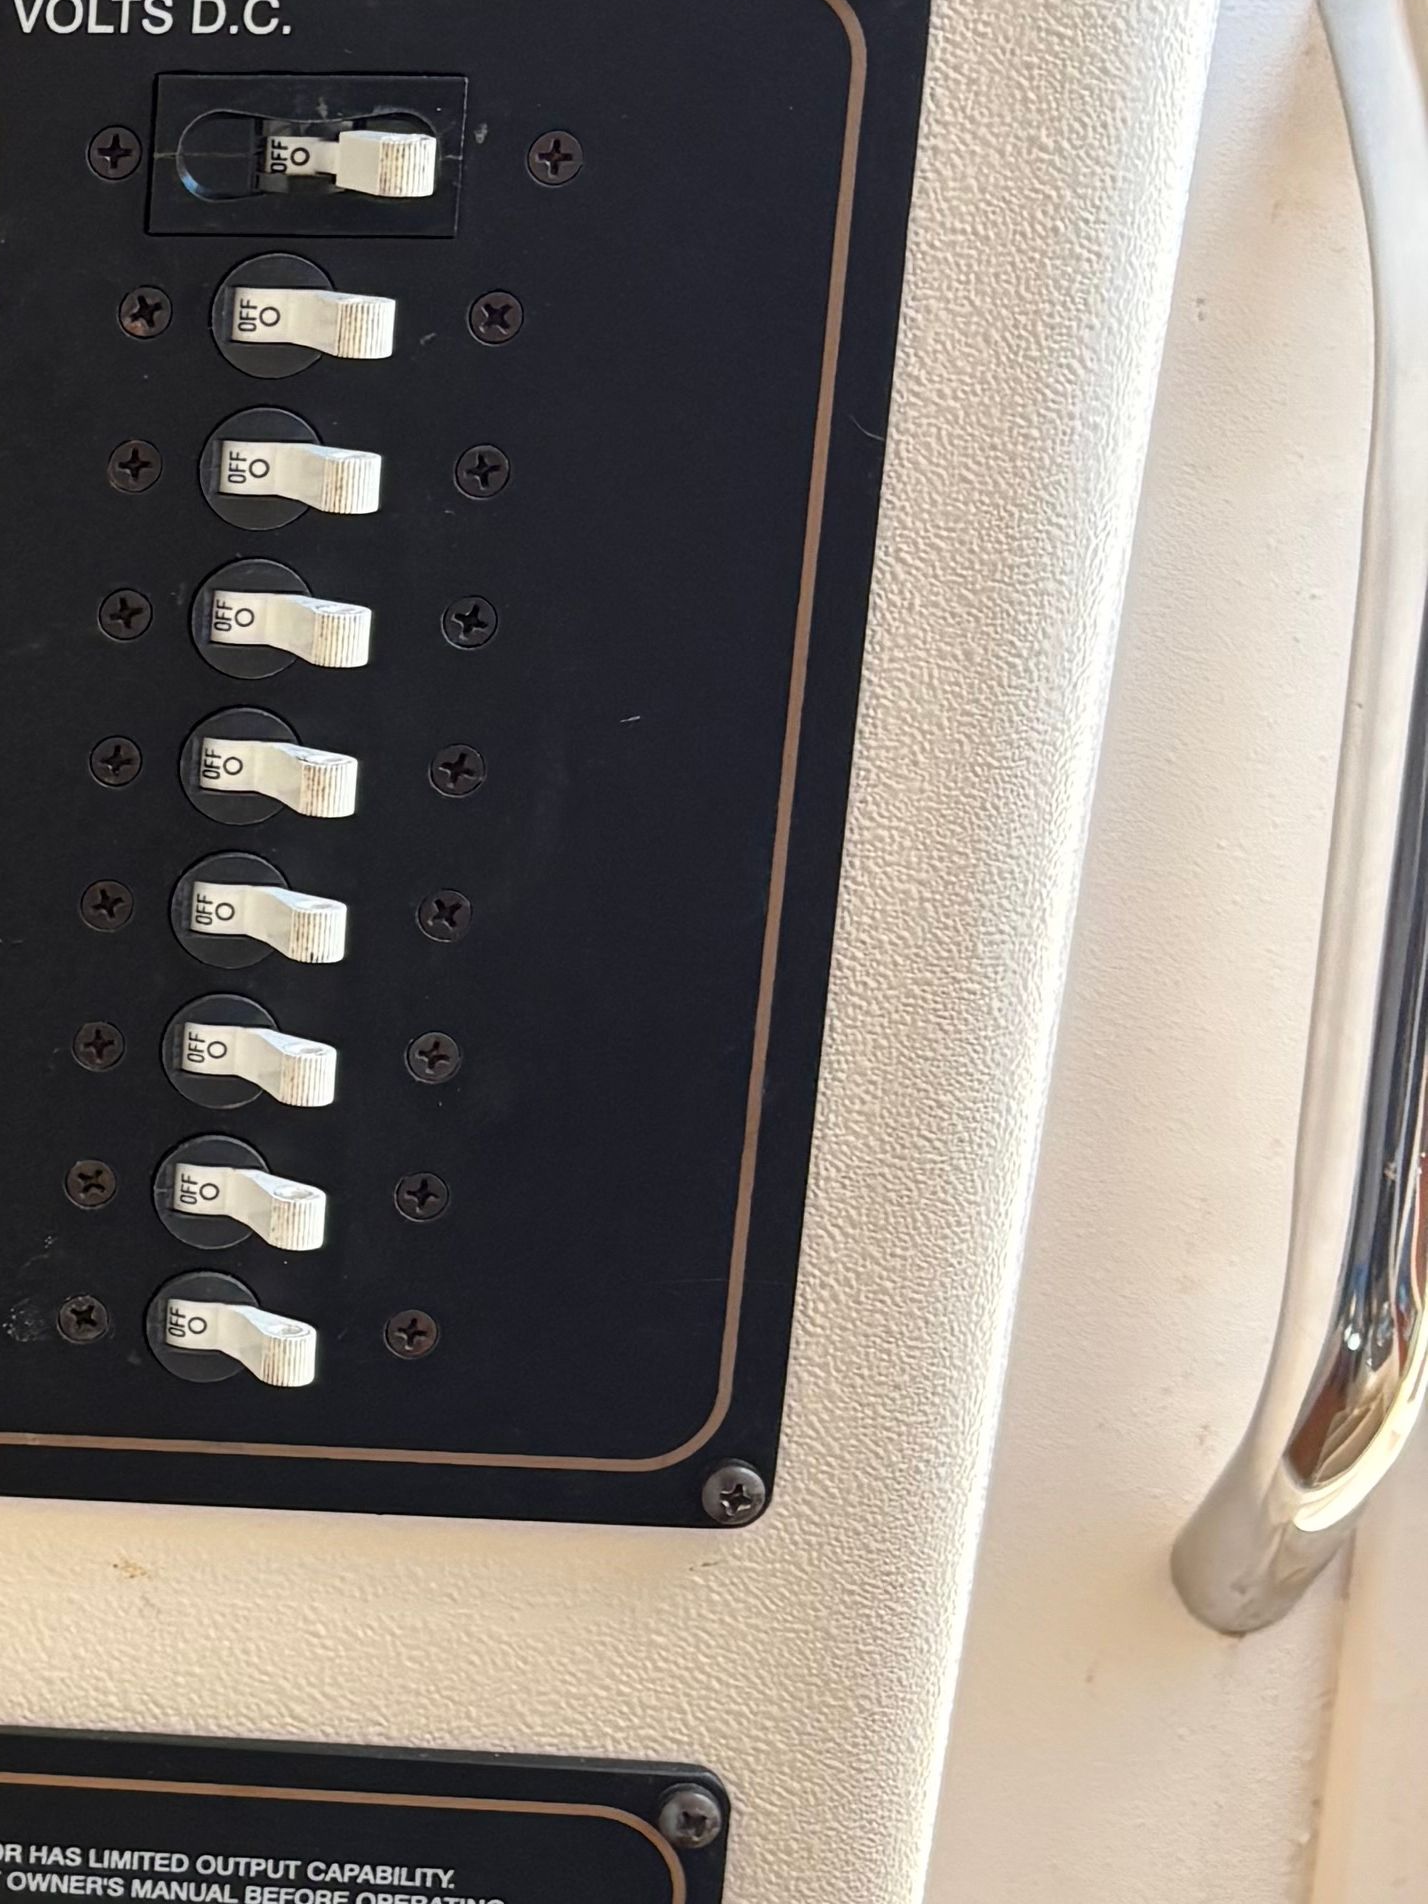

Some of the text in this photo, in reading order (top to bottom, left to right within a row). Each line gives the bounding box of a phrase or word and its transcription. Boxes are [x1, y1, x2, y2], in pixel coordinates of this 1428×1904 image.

[30, 1846, 81, 1866] HAS
[89, 1849, 189, 1872] LIMITED
[196, 1855, 301, 1879] OUTPUT
[307, 1862, 454, 1888] CAPABILITY.
[7, 1872, 124, 1896] OWNER'S
[131, 1879, 238, 1903] MANUAL
